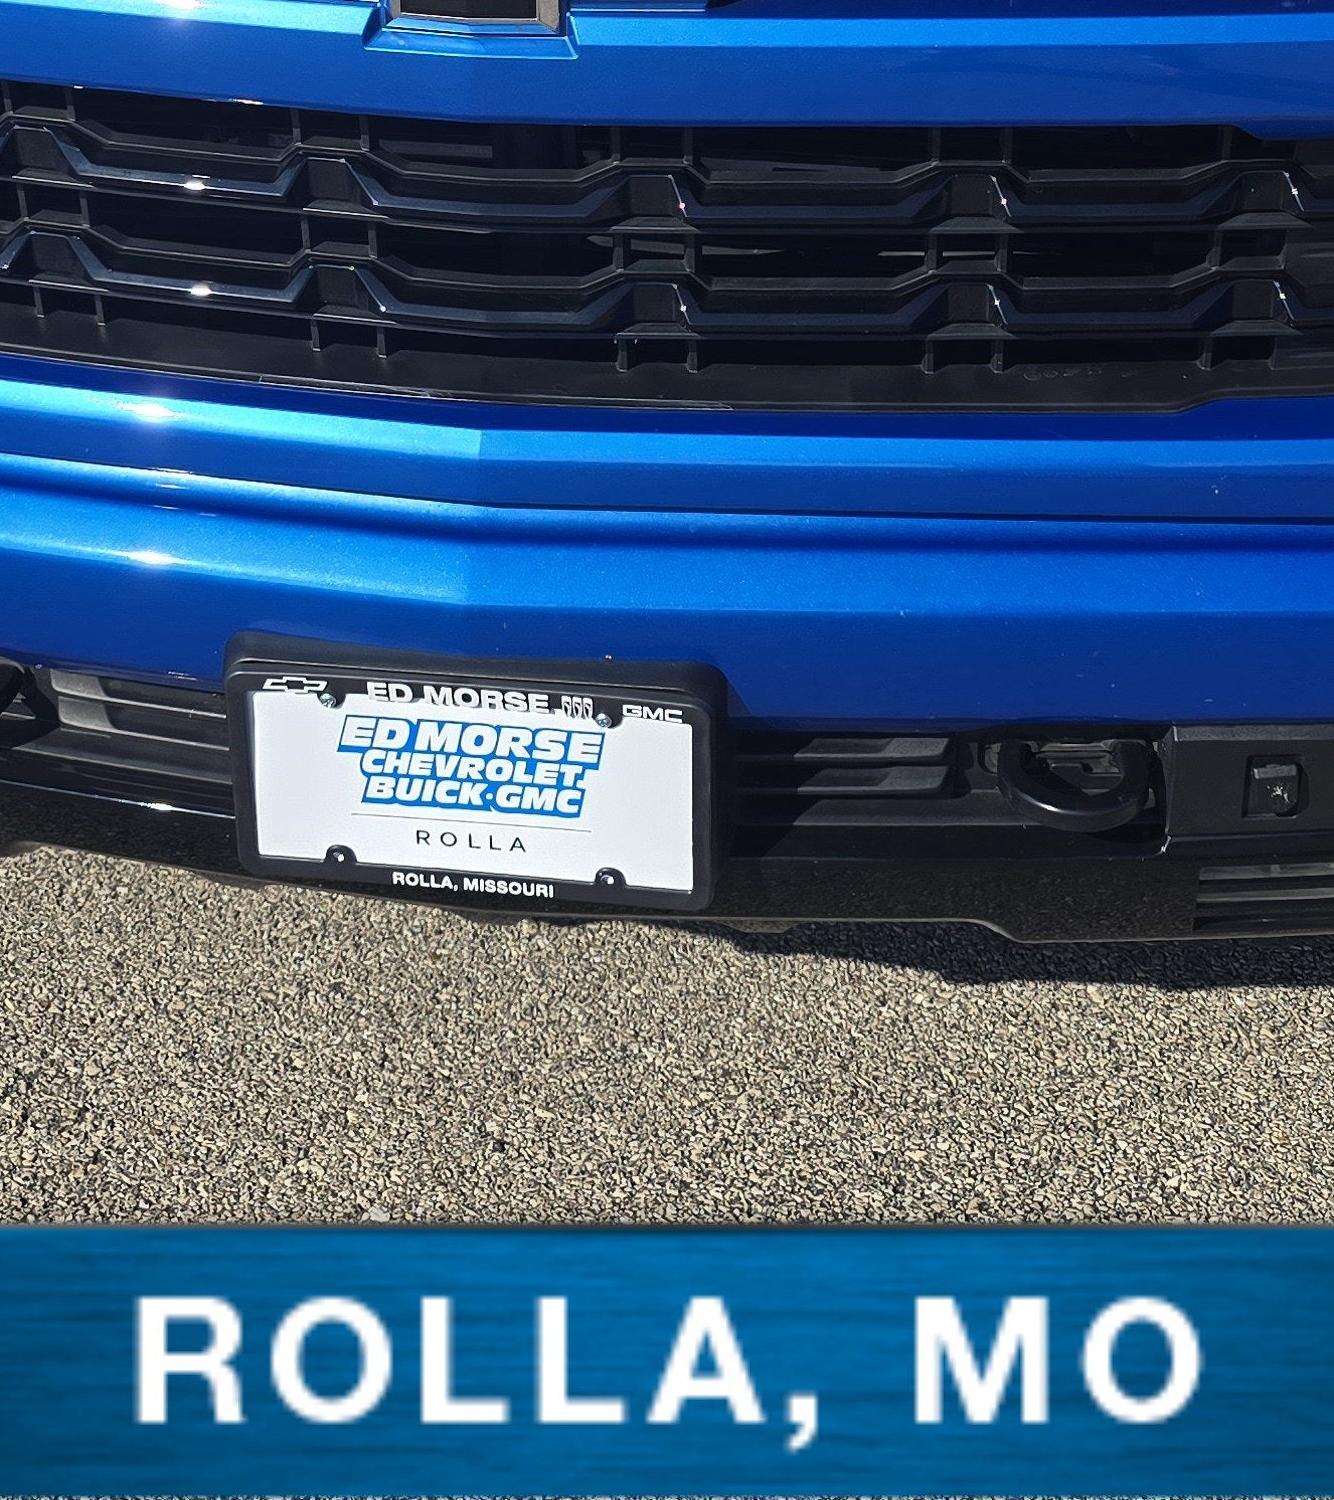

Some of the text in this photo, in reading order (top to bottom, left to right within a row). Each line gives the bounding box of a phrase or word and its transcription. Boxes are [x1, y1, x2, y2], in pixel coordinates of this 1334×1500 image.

[367, 681, 551, 714] ED MORSE
[622, 704, 684, 724] GMC
[340, 716, 604, 763] ED MORSE
[416, 830, 527, 853] ROLLA
[392, 871, 555, 899] ROLLA, MISSOURI
